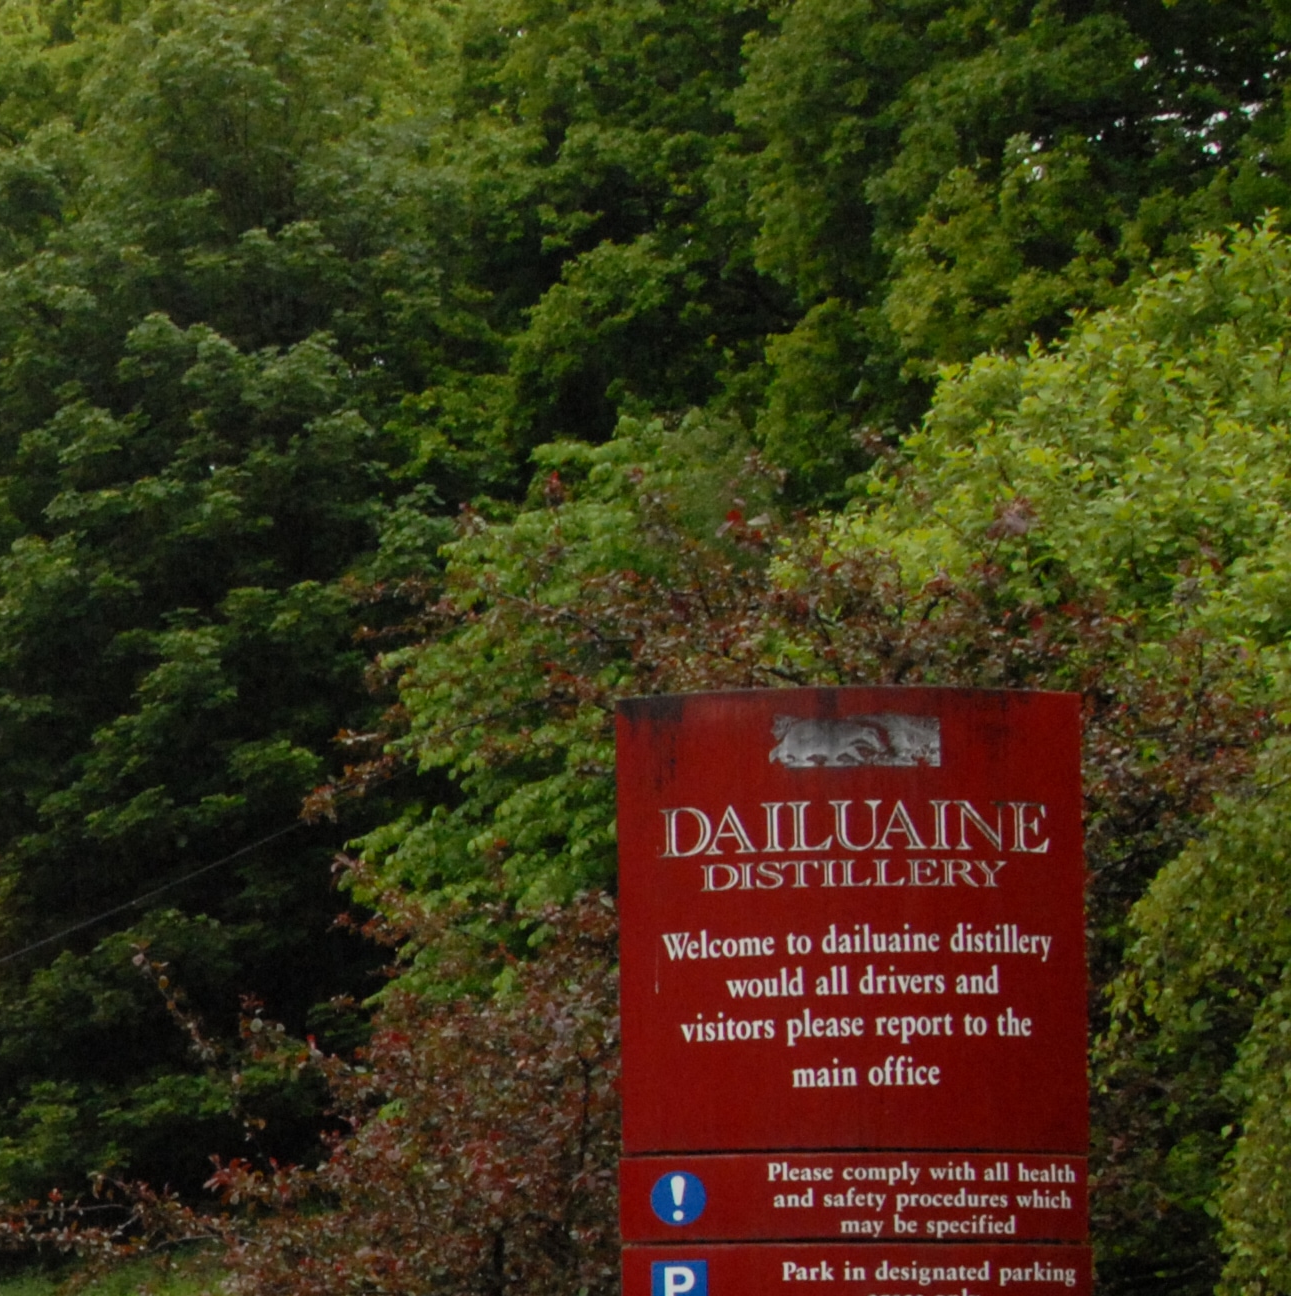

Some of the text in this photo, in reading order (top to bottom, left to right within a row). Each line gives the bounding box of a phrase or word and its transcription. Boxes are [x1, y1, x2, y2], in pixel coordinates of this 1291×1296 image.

[660, 799, 1050, 858] DAILUAINE
[700, 858, 1007, 892] DISTILLERY
[661, 922, 1052, 963] Welcome to dailuaine distillery
[725, 964, 999, 999] would all drivers and
[680, 1006, 1032, 1047] visitors please report to the
[791, 1055, 940, 1088] main office
[767, 1160, 1076, 1186] Please comply with all health
[773, 1187, 1072, 1212] and safety procedures which
[840, 1213, 1016, 1238] may be specified
[782, 1260, 1076, 1287] Park in designated parking
